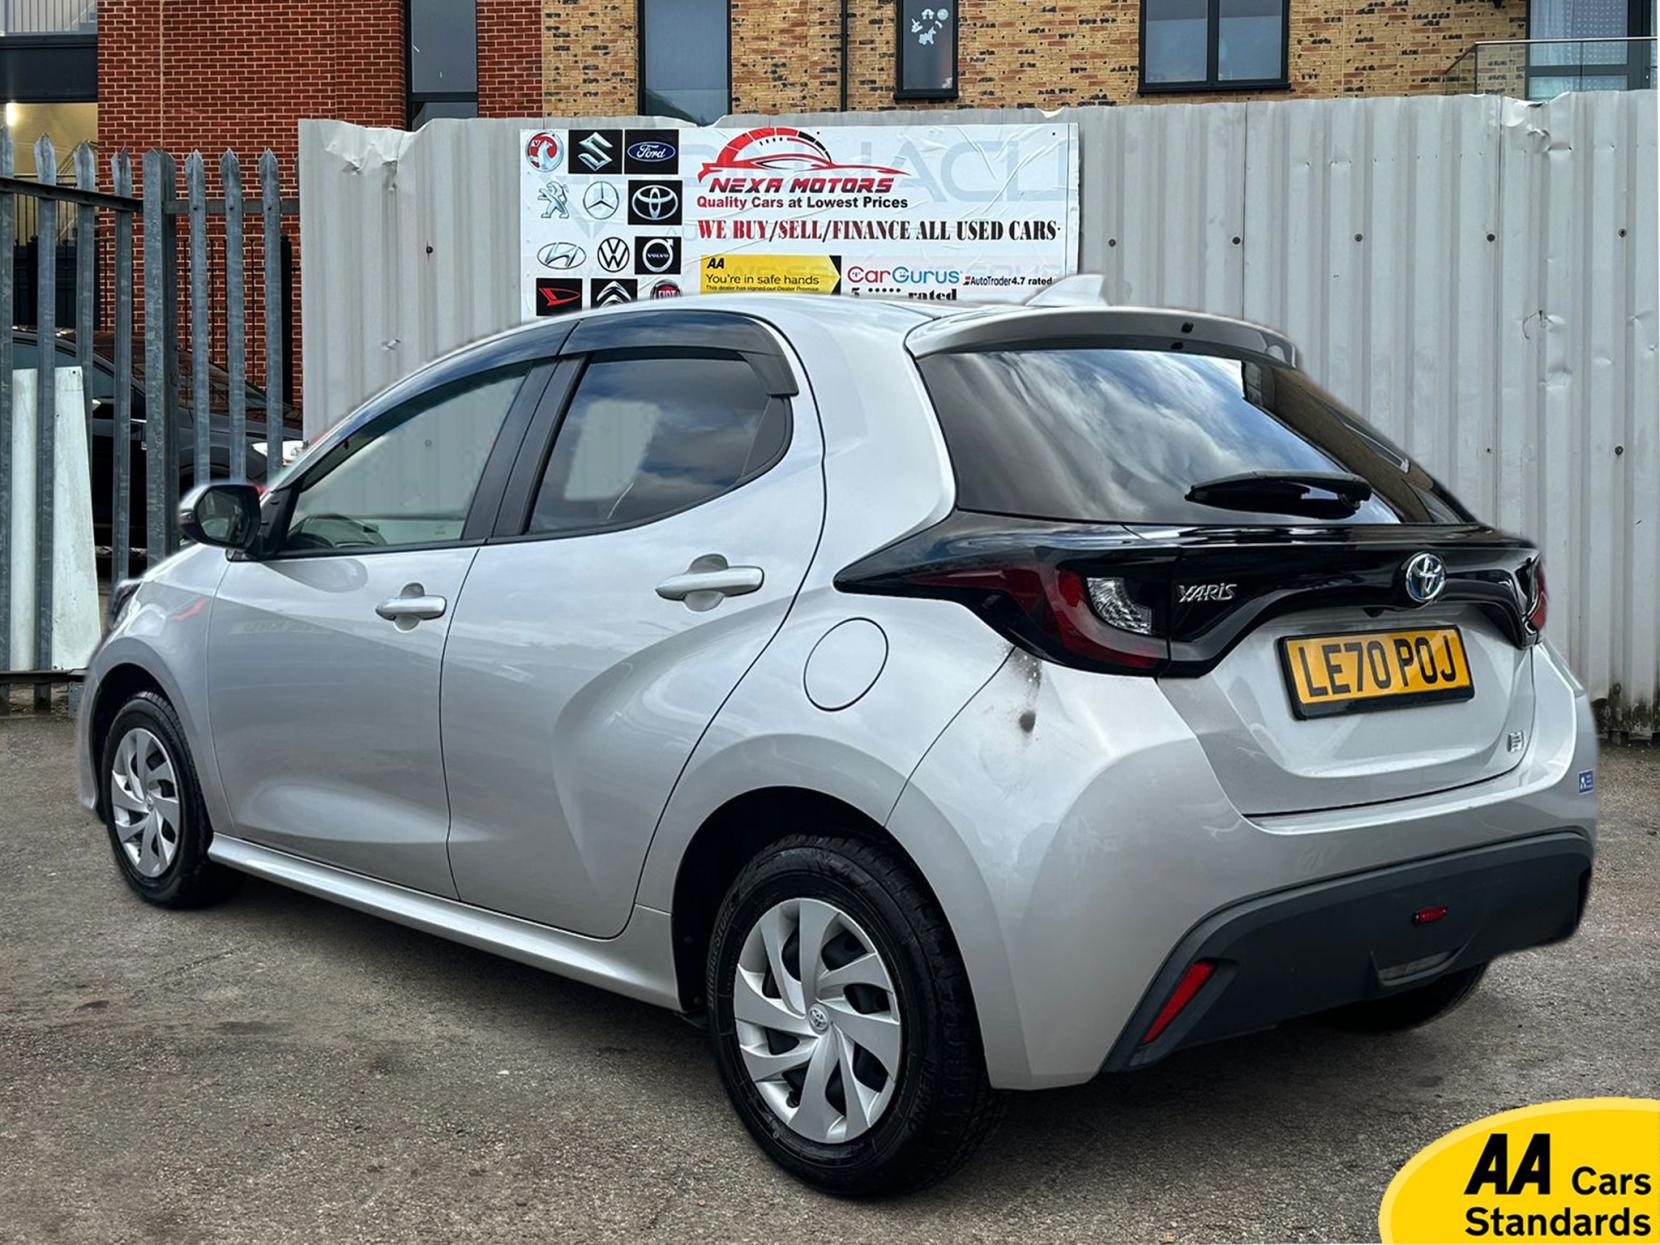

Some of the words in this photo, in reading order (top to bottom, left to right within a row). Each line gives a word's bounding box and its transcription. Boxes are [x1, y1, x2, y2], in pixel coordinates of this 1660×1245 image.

[636, 144, 666, 159] Ford
[708, 177, 784, 194] NEXA
[788, 177, 895, 194] MOTORS
[696, 195, 748, 210] Quality
[752, 196, 784, 208] Cars
[788, 196, 803, 208] at
[807, 196, 859, 208] Lowest
[863, 196, 908, 208] Prices
[697, 219, 727, 240] WE
[915, 220, 951, 241] ALL
[956, 220, 1004, 241] USED
[1008, 220, 1057, 241] CARS
[706, 257, 725, 269] AA
[705, 273, 741, 285] You're
[743, 274, 754, 284] in
[757, 274, 780, 284] safe
[783, 274, 820, 285] hands
[847, 265, 960, 284] CarGurus
[1027, 276, 1053, 286] rated
[908, 288, 958, 301] rated
[1178, 581, 1238, 603] YARIS
[1298, 639, 1392, 698] LE70
[1392, 634, 1457, 688] POJ
